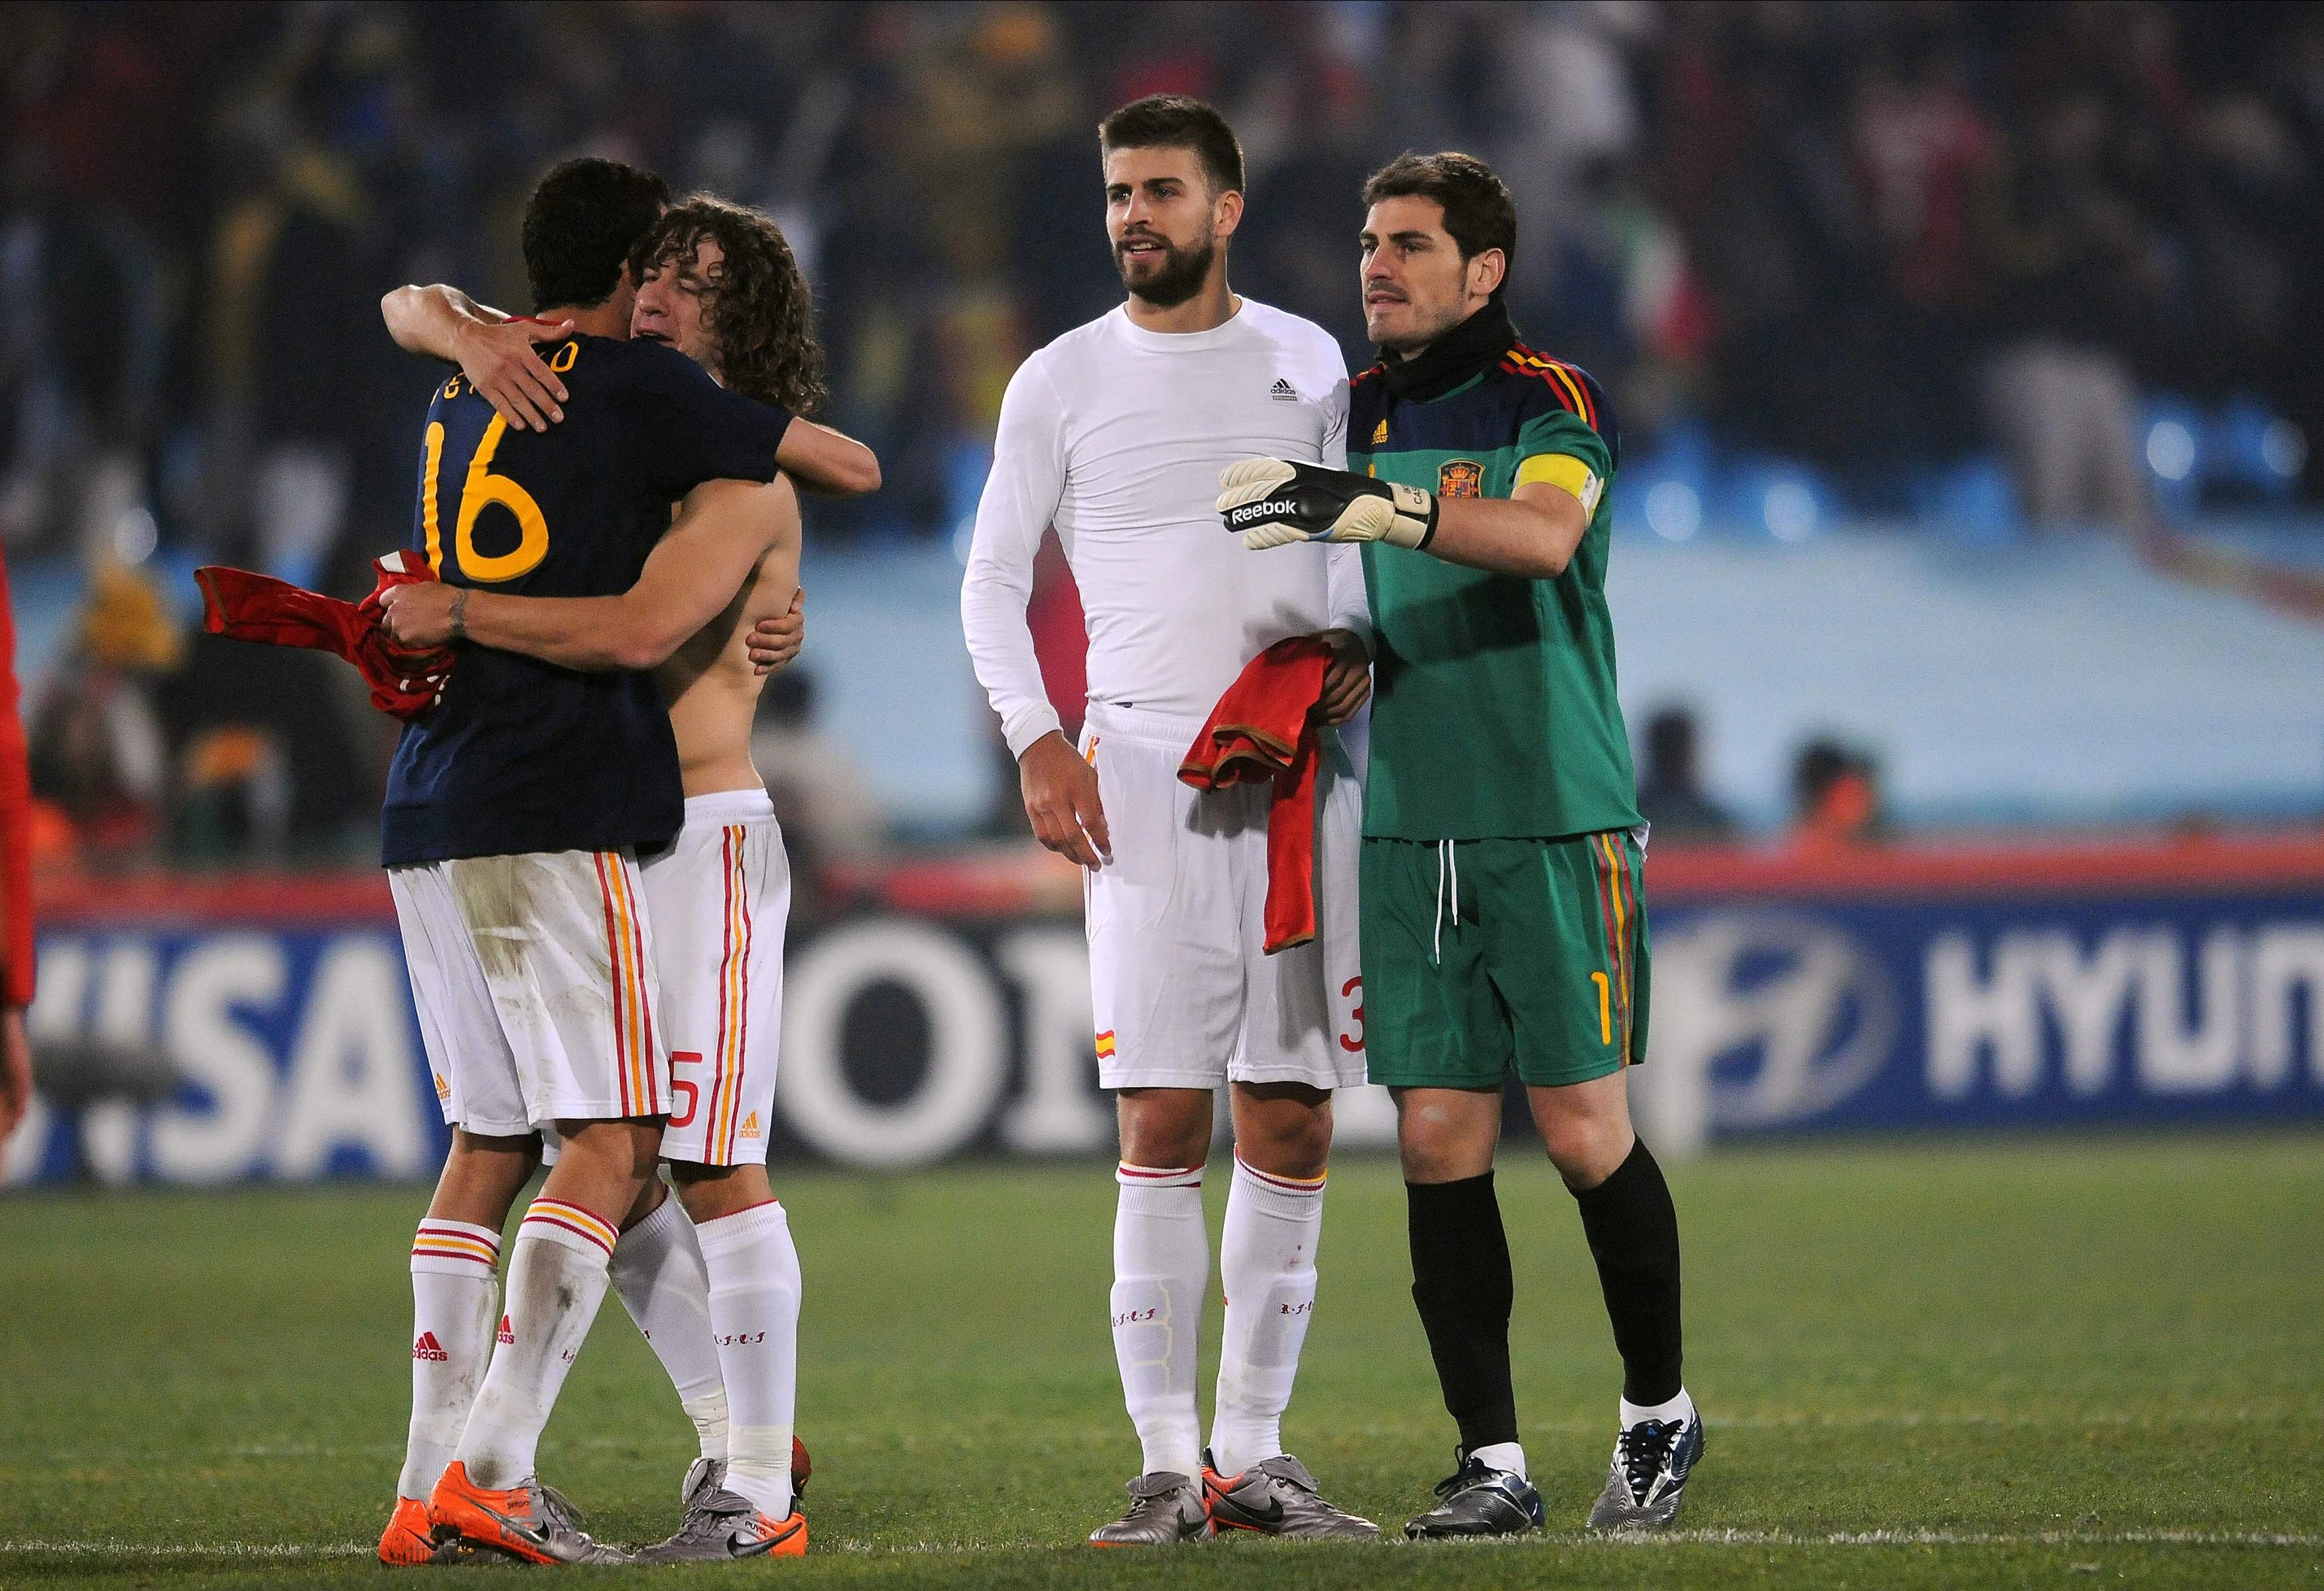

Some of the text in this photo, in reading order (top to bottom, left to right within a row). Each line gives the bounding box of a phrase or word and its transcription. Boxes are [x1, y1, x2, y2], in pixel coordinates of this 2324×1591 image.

[423, 411, 549, 583] 16
[1232, 499, 1297, 525] Reebok
[1340, 976, 1366, 1052] 3
[1591, 972, 1611, 1044] 1
[667, 1051, 702, 1127] 5
